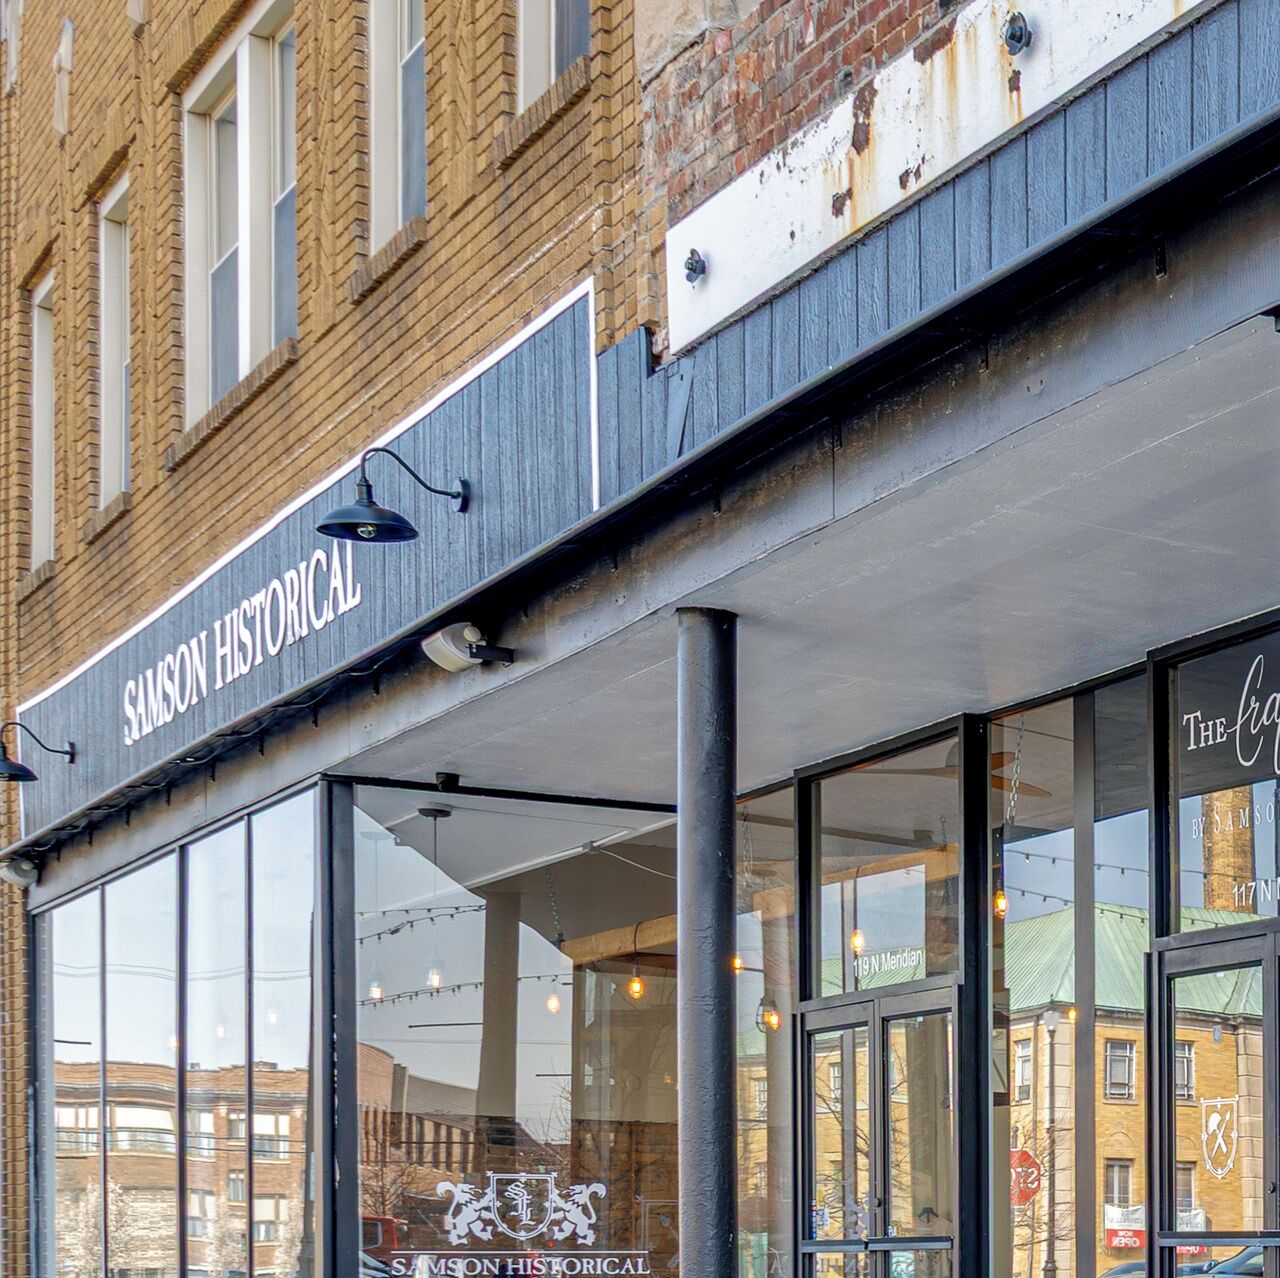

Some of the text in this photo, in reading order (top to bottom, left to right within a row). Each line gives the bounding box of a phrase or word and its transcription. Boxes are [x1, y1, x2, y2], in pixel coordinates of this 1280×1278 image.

[123, 539, 363, 746] SAMSON HISTORICAL
[1182, 710, 1228, 752] THE
[1232, 881, 1256, 907] 117
[1260, 878, 1272, 903] N
[853, 947, 924, 977] 119 N Meridian
[391, 1256, 651, 1276] SAMSON HISTORICAL
